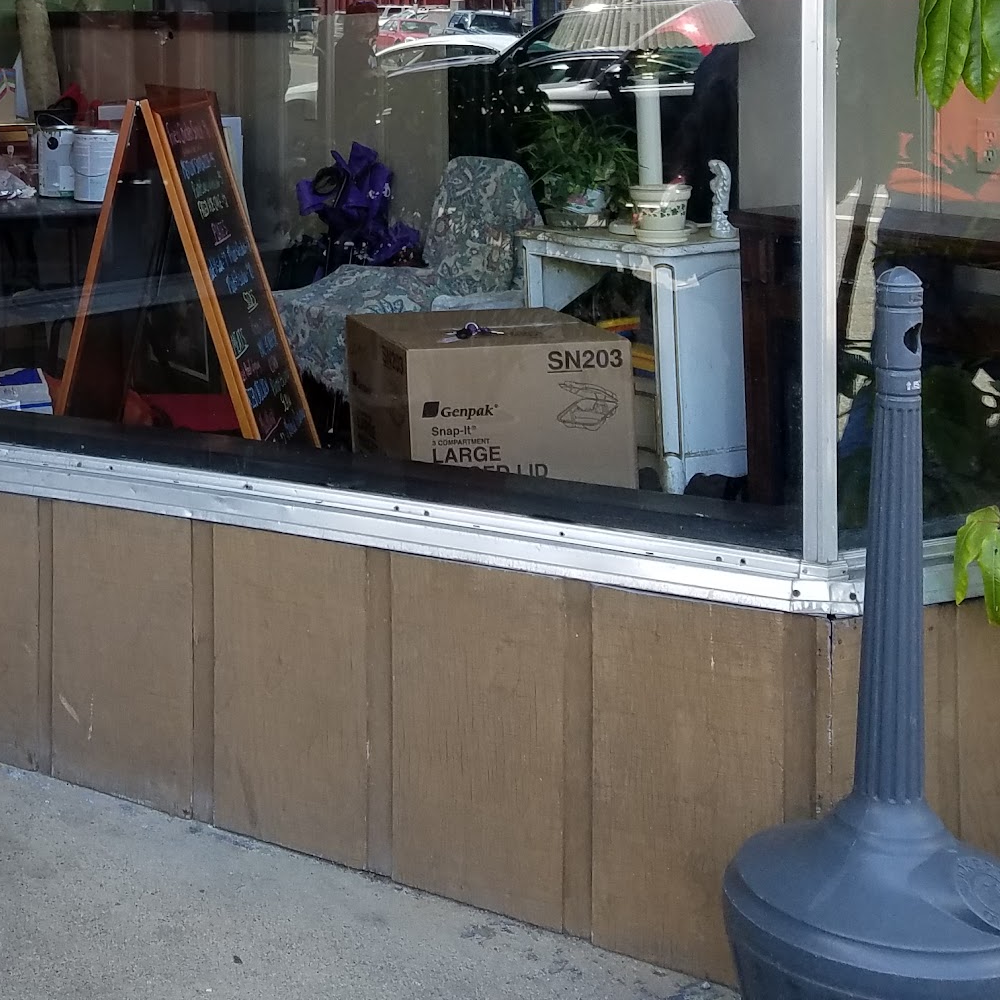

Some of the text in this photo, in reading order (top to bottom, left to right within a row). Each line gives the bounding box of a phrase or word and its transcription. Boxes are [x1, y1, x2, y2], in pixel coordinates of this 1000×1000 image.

[547, 348, 624, 371] SN203
[437, 438, 491, 447] COMPARTMENT
[432, 446, 502, 464] LARGE
